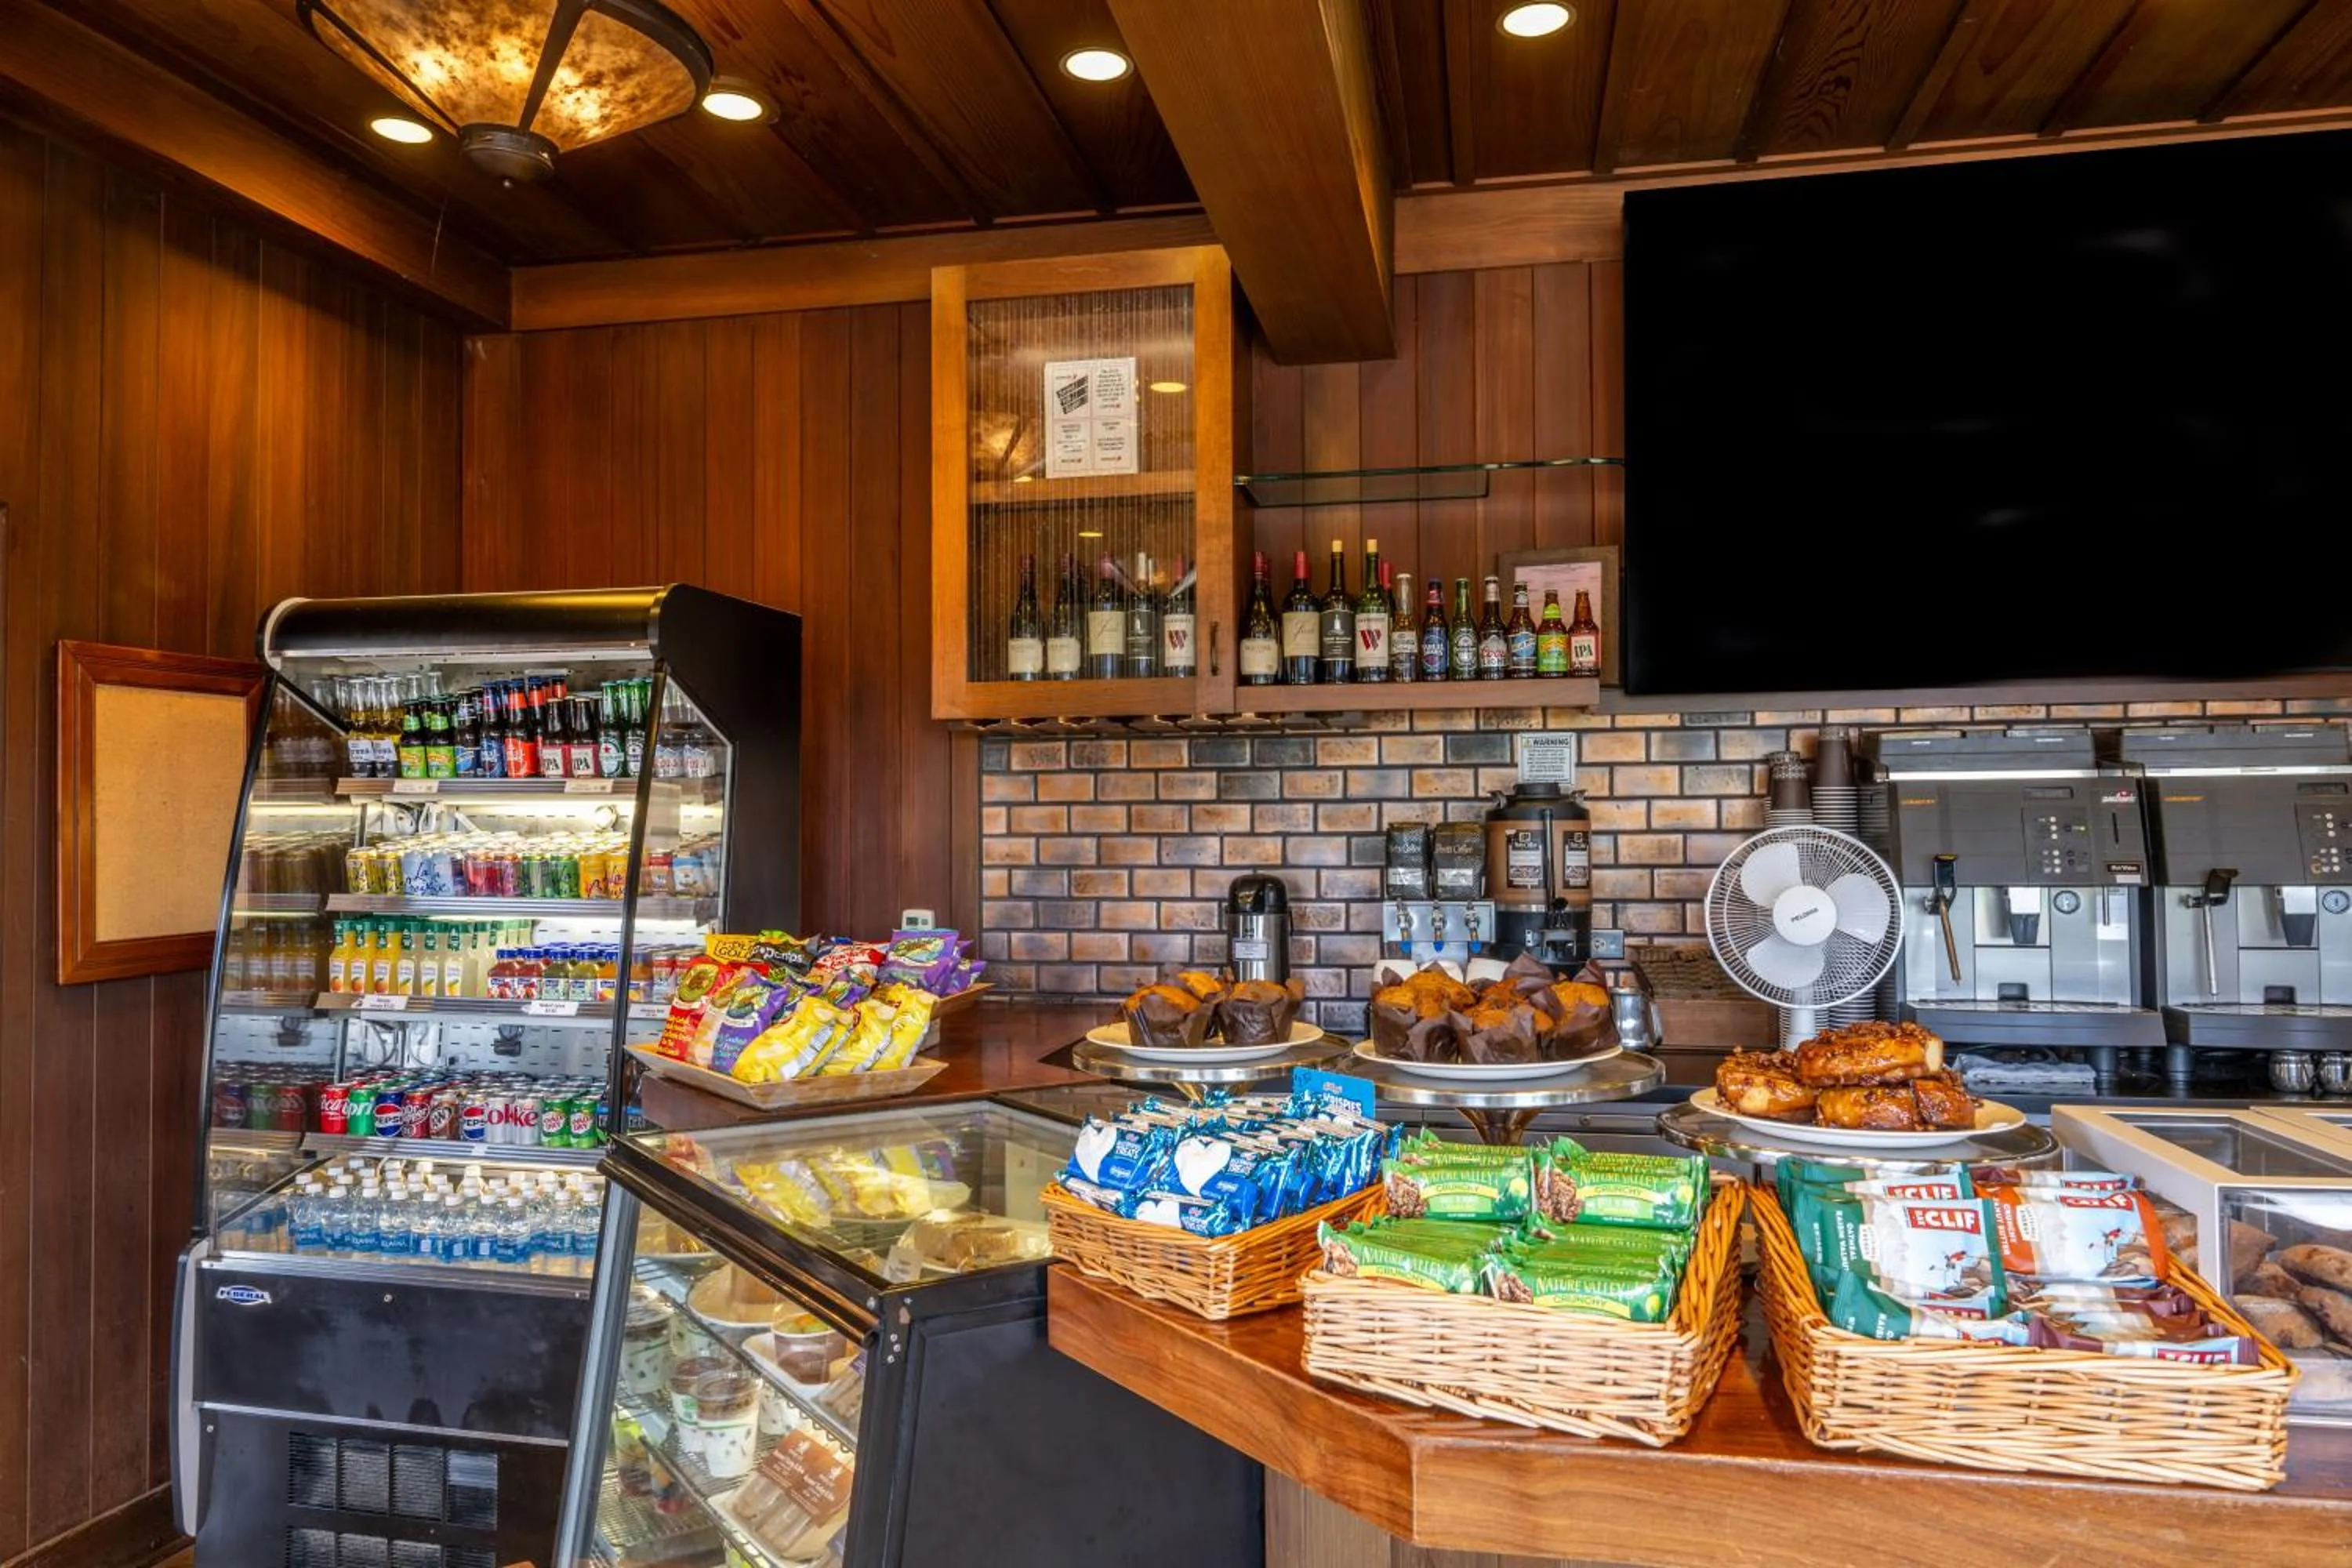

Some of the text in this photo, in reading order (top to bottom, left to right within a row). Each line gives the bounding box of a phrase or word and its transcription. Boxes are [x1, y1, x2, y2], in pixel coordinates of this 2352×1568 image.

[1360, 629, 1381, 651] W
[1574, 644, 1593, 658] IPA
[1533, 738, 1570, 746] WARNING
[1422, 1170, 1494, 1185] NATURE VALLEY
[1580, 1173, 1657, 1190] NATURE VALLEY
[1436, 1183, 1479, 1193] CRUNCHY
[1595, 1185, 1643, 1196] CRUNCHY
[1835, 1210, 1846, 1240] RAISIN
[1925, 1210, 1976, 1230] CLIF
[2003, 1203, 2017, 1243] CRUNCHY
[1846, 1222, 1857, 1261] OATMEAL
[1361, 1246, 1403, 1265] NATURE
[1536, 1277, 1627, 1295] NATURE VALLEY
[1553, 1294, 1607, 1308] CRUNCHY
